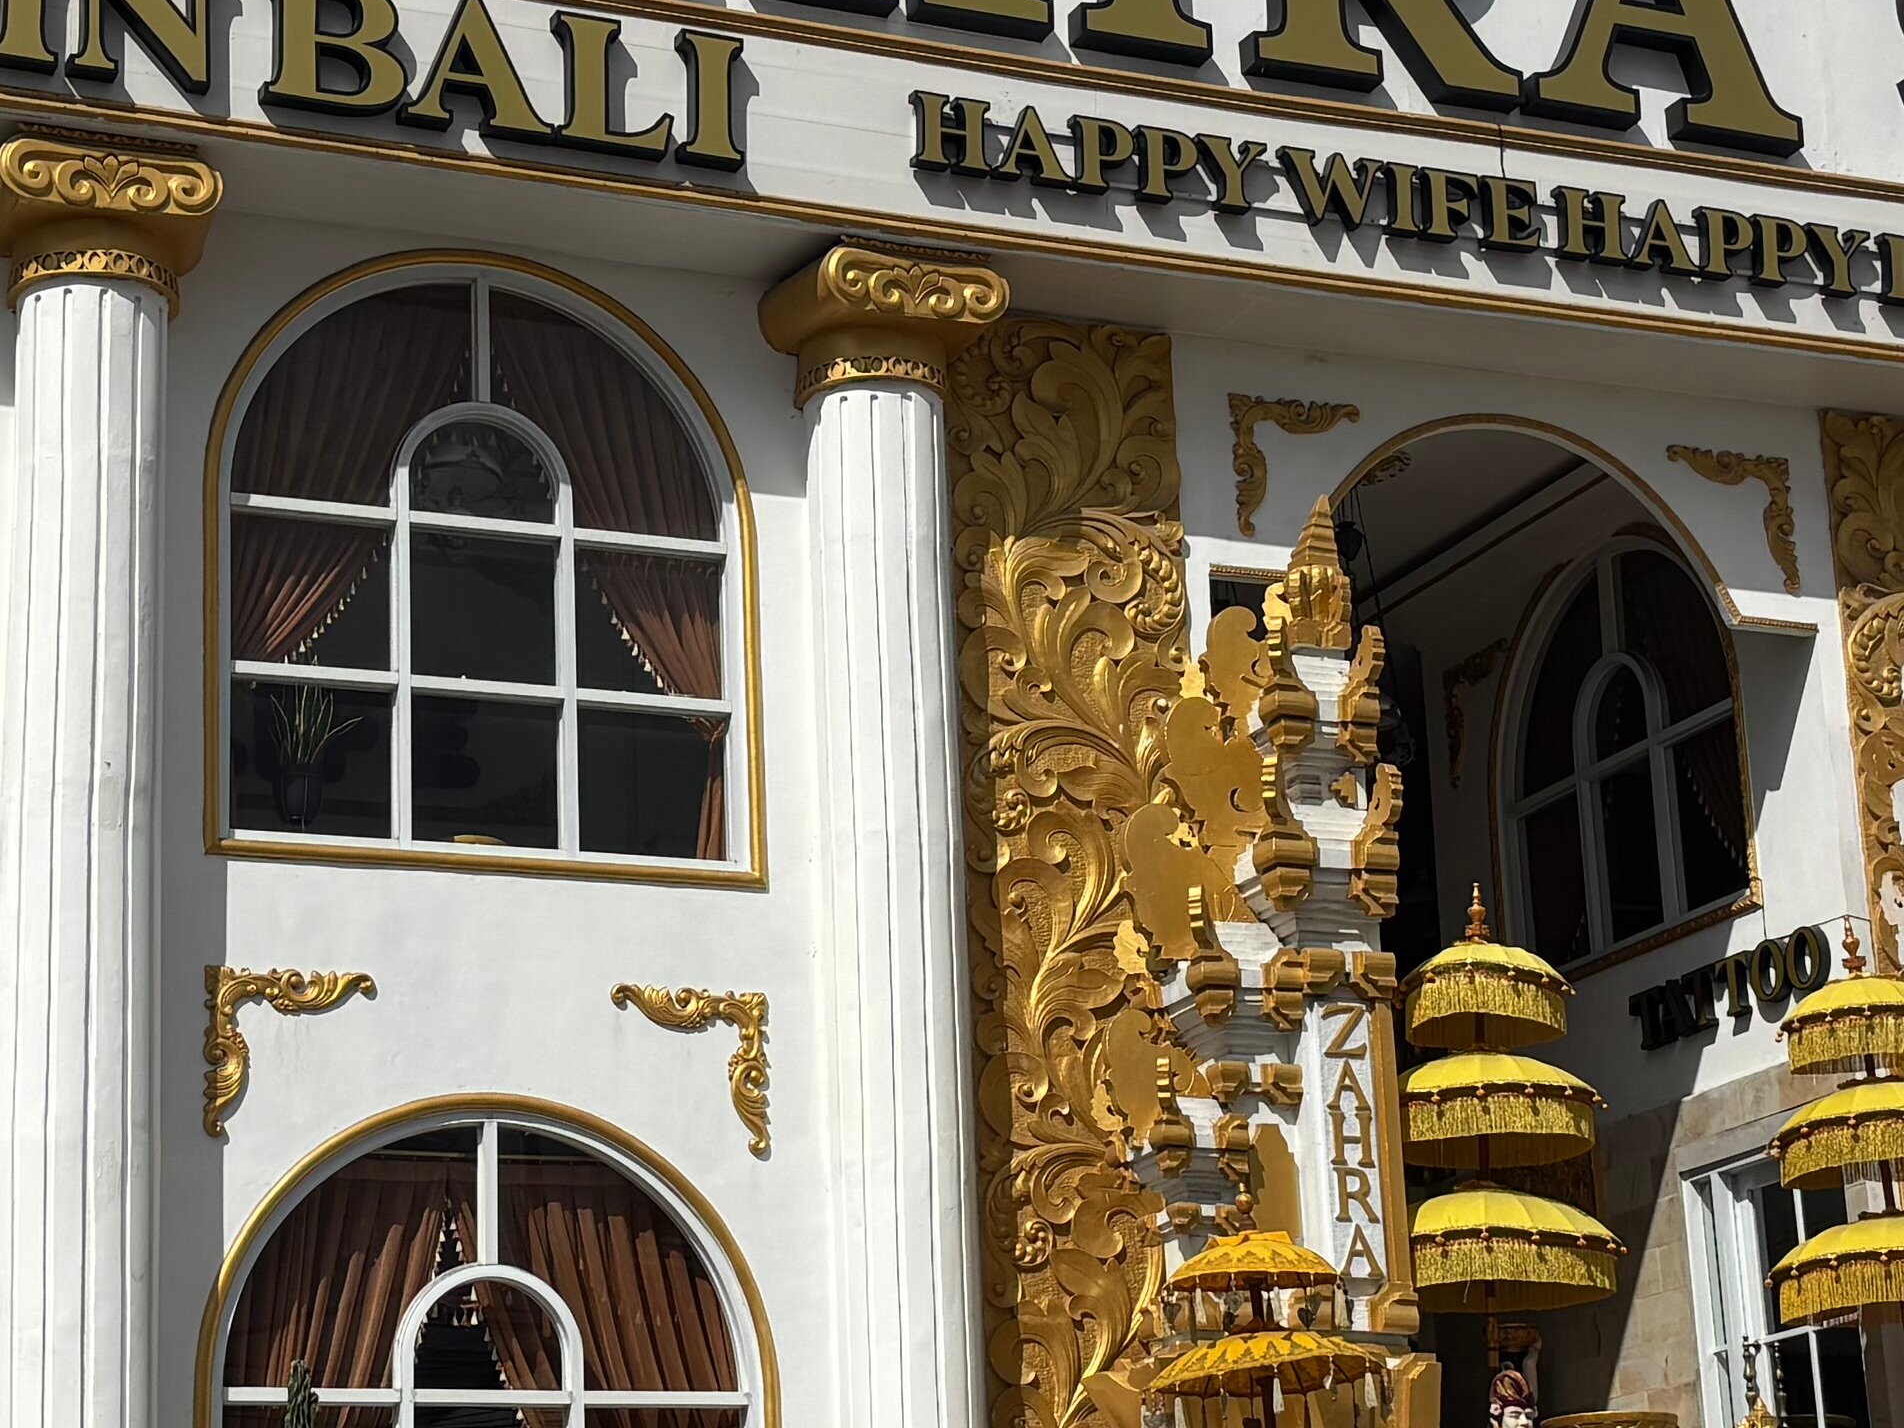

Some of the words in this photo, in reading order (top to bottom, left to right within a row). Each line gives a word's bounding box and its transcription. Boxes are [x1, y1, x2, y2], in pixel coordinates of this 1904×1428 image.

[908, 90, 1268, 214] HAPPY
[1278, 145, 1544, 252] WIFE
[1551, 185, 1867, 298] HAPPY
[1628, 926, 1832, 1051] TATTOO
[1320, 1002, 1386, 1278] ZAHRA
